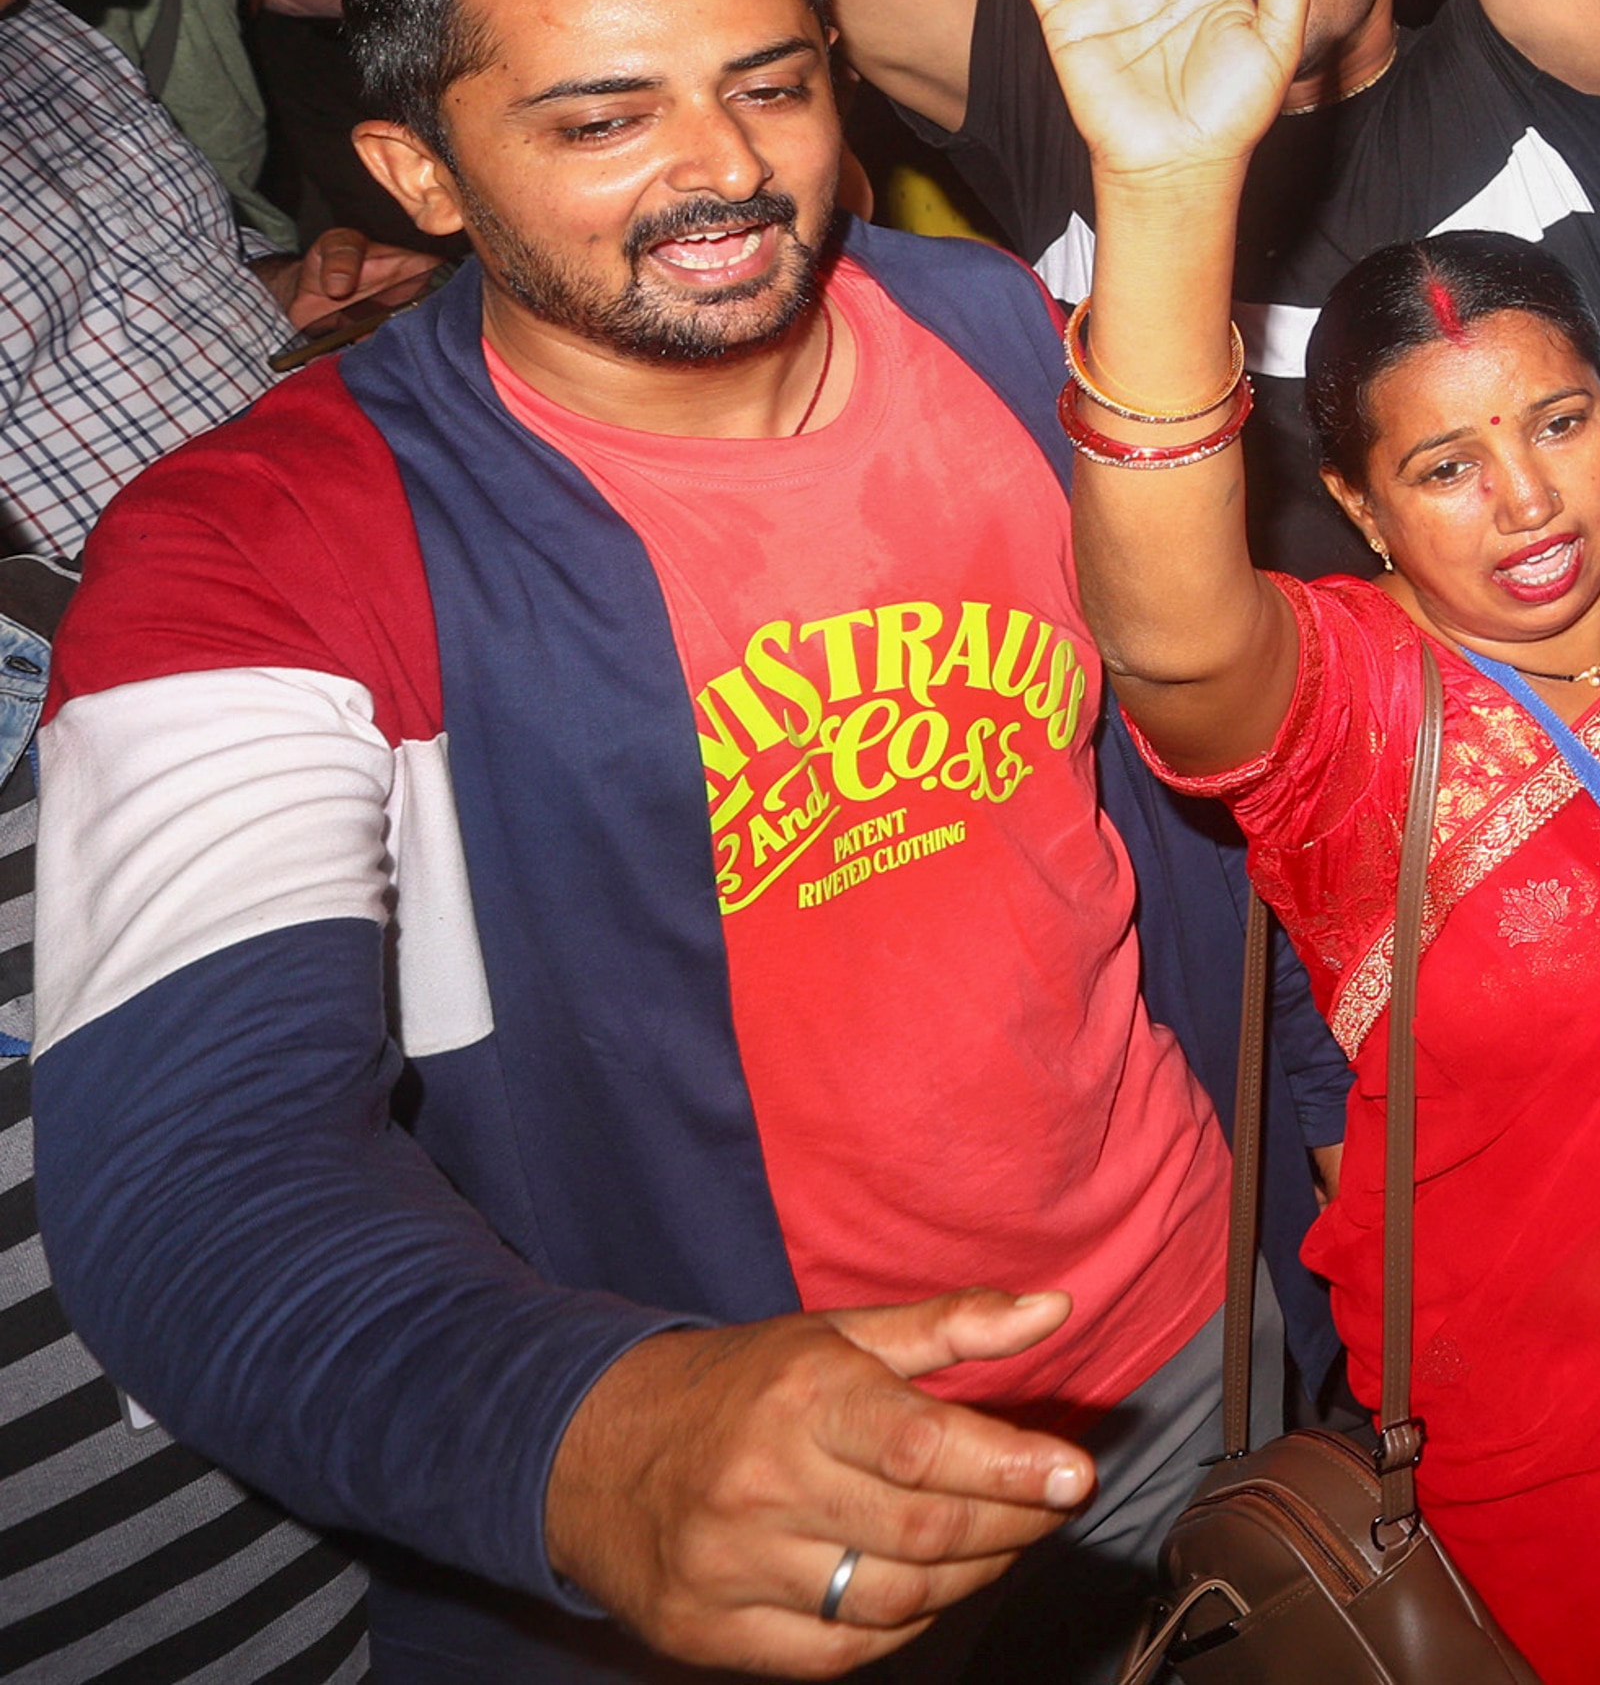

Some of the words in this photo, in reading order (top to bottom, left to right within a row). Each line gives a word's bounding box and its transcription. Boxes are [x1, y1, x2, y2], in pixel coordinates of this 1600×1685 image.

[798, 857, 873, 911] RIVETED
[874, 820, 966, 875] CLOTHING
[833, 807, 908, 864] PATENT
